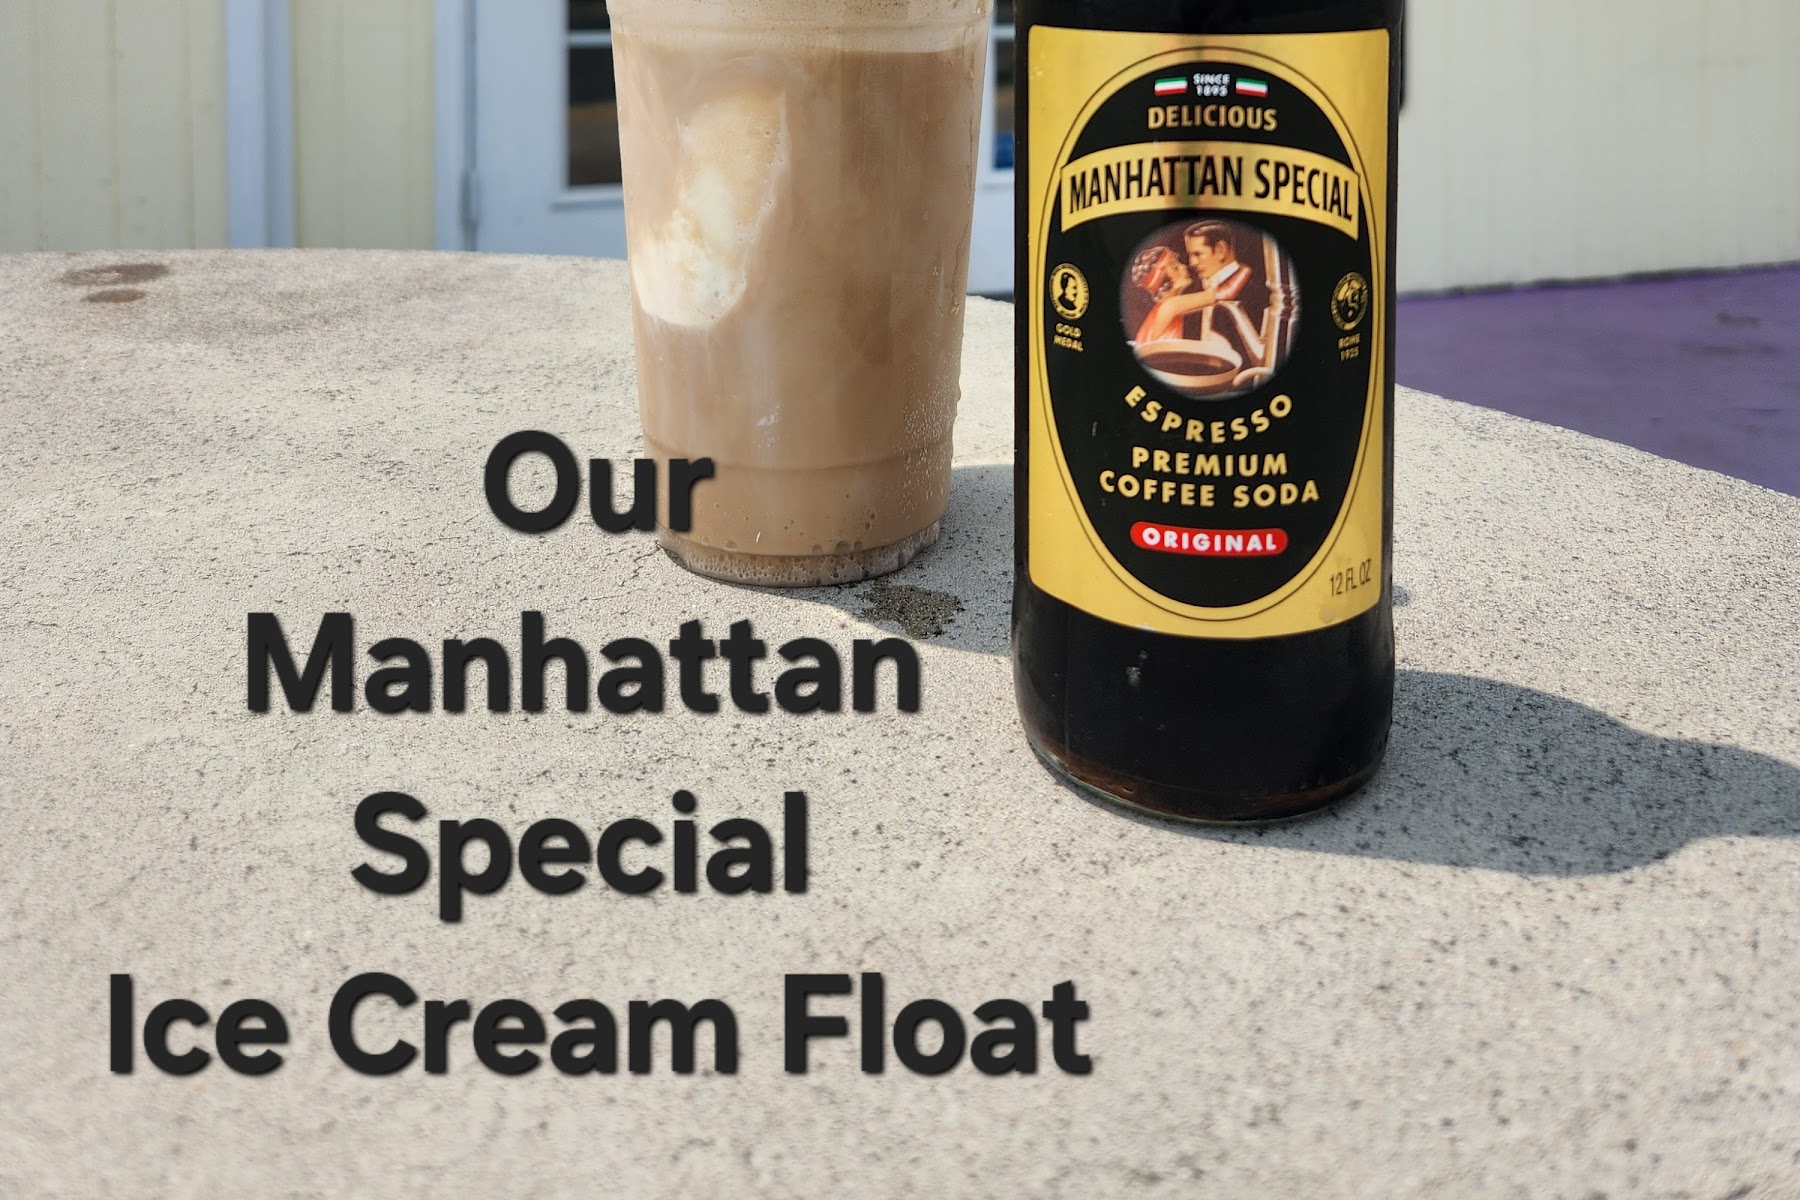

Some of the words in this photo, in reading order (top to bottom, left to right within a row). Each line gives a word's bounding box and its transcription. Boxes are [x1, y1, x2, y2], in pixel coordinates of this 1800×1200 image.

[1193, 72, 1231, 85] SINCE
[1148, 104, 1278, 132] DELICIOUS
[1069, 155, 1243, 215] MANHATTAN
[1254, 158, 1352, 222] SPECIAL
[1053, 334, 1084, 352] MEDAL
[1055, 322, 1082, 339] GOLD
[1124, 385, 1293, 444] ESPRESSO
[1131, 446, 1288, 477] PREMIUM
[1099, 470, 1215, 507] COFFEE
[1233, 479, 1319, 507] SODA
[1142, 527, 1277, 552] ORIGINAL
[1329, 572, 1343, 597] 12
[1359, 558, 1371, 585] OZ
